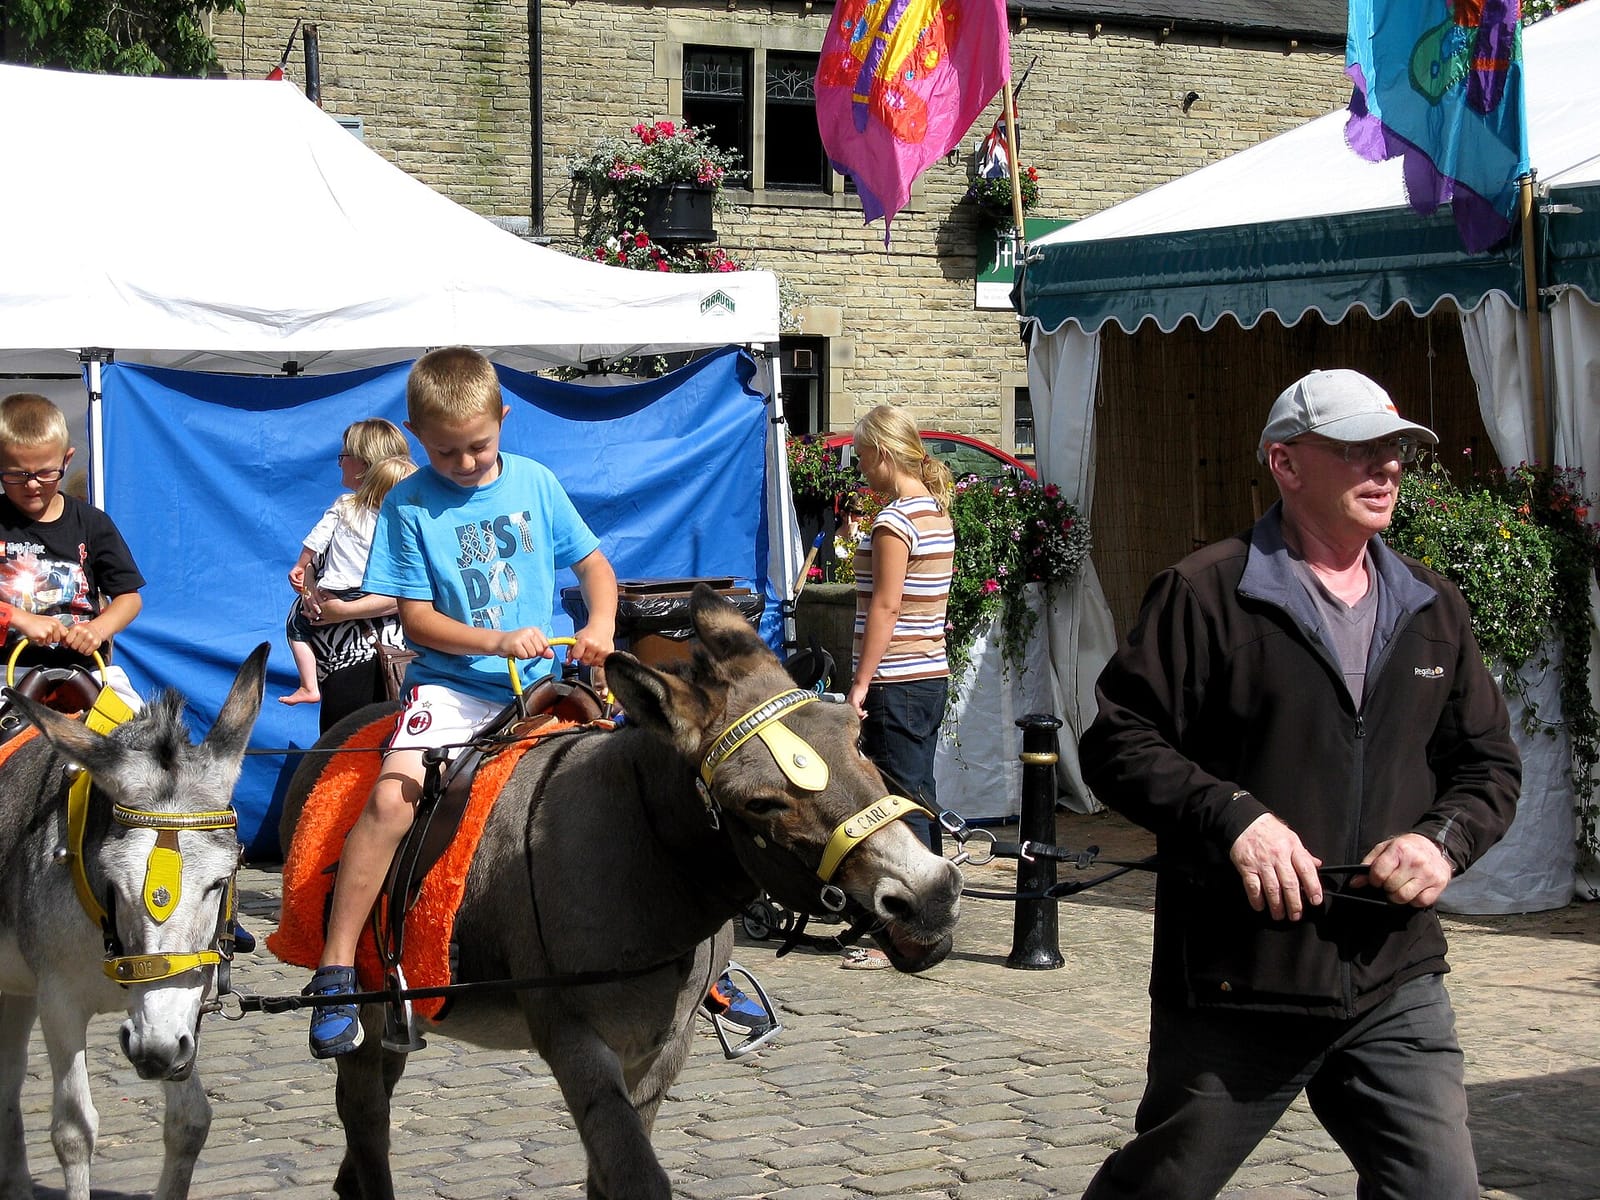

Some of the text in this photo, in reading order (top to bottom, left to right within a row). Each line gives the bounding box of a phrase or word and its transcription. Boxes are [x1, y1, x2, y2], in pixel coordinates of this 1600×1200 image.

[700, 291, 736, 313] CARAVAN
[455, 511, 534, 569] JUST
[460, 561, 519, 610] DO
[857, 806, 890, 829] CARL
